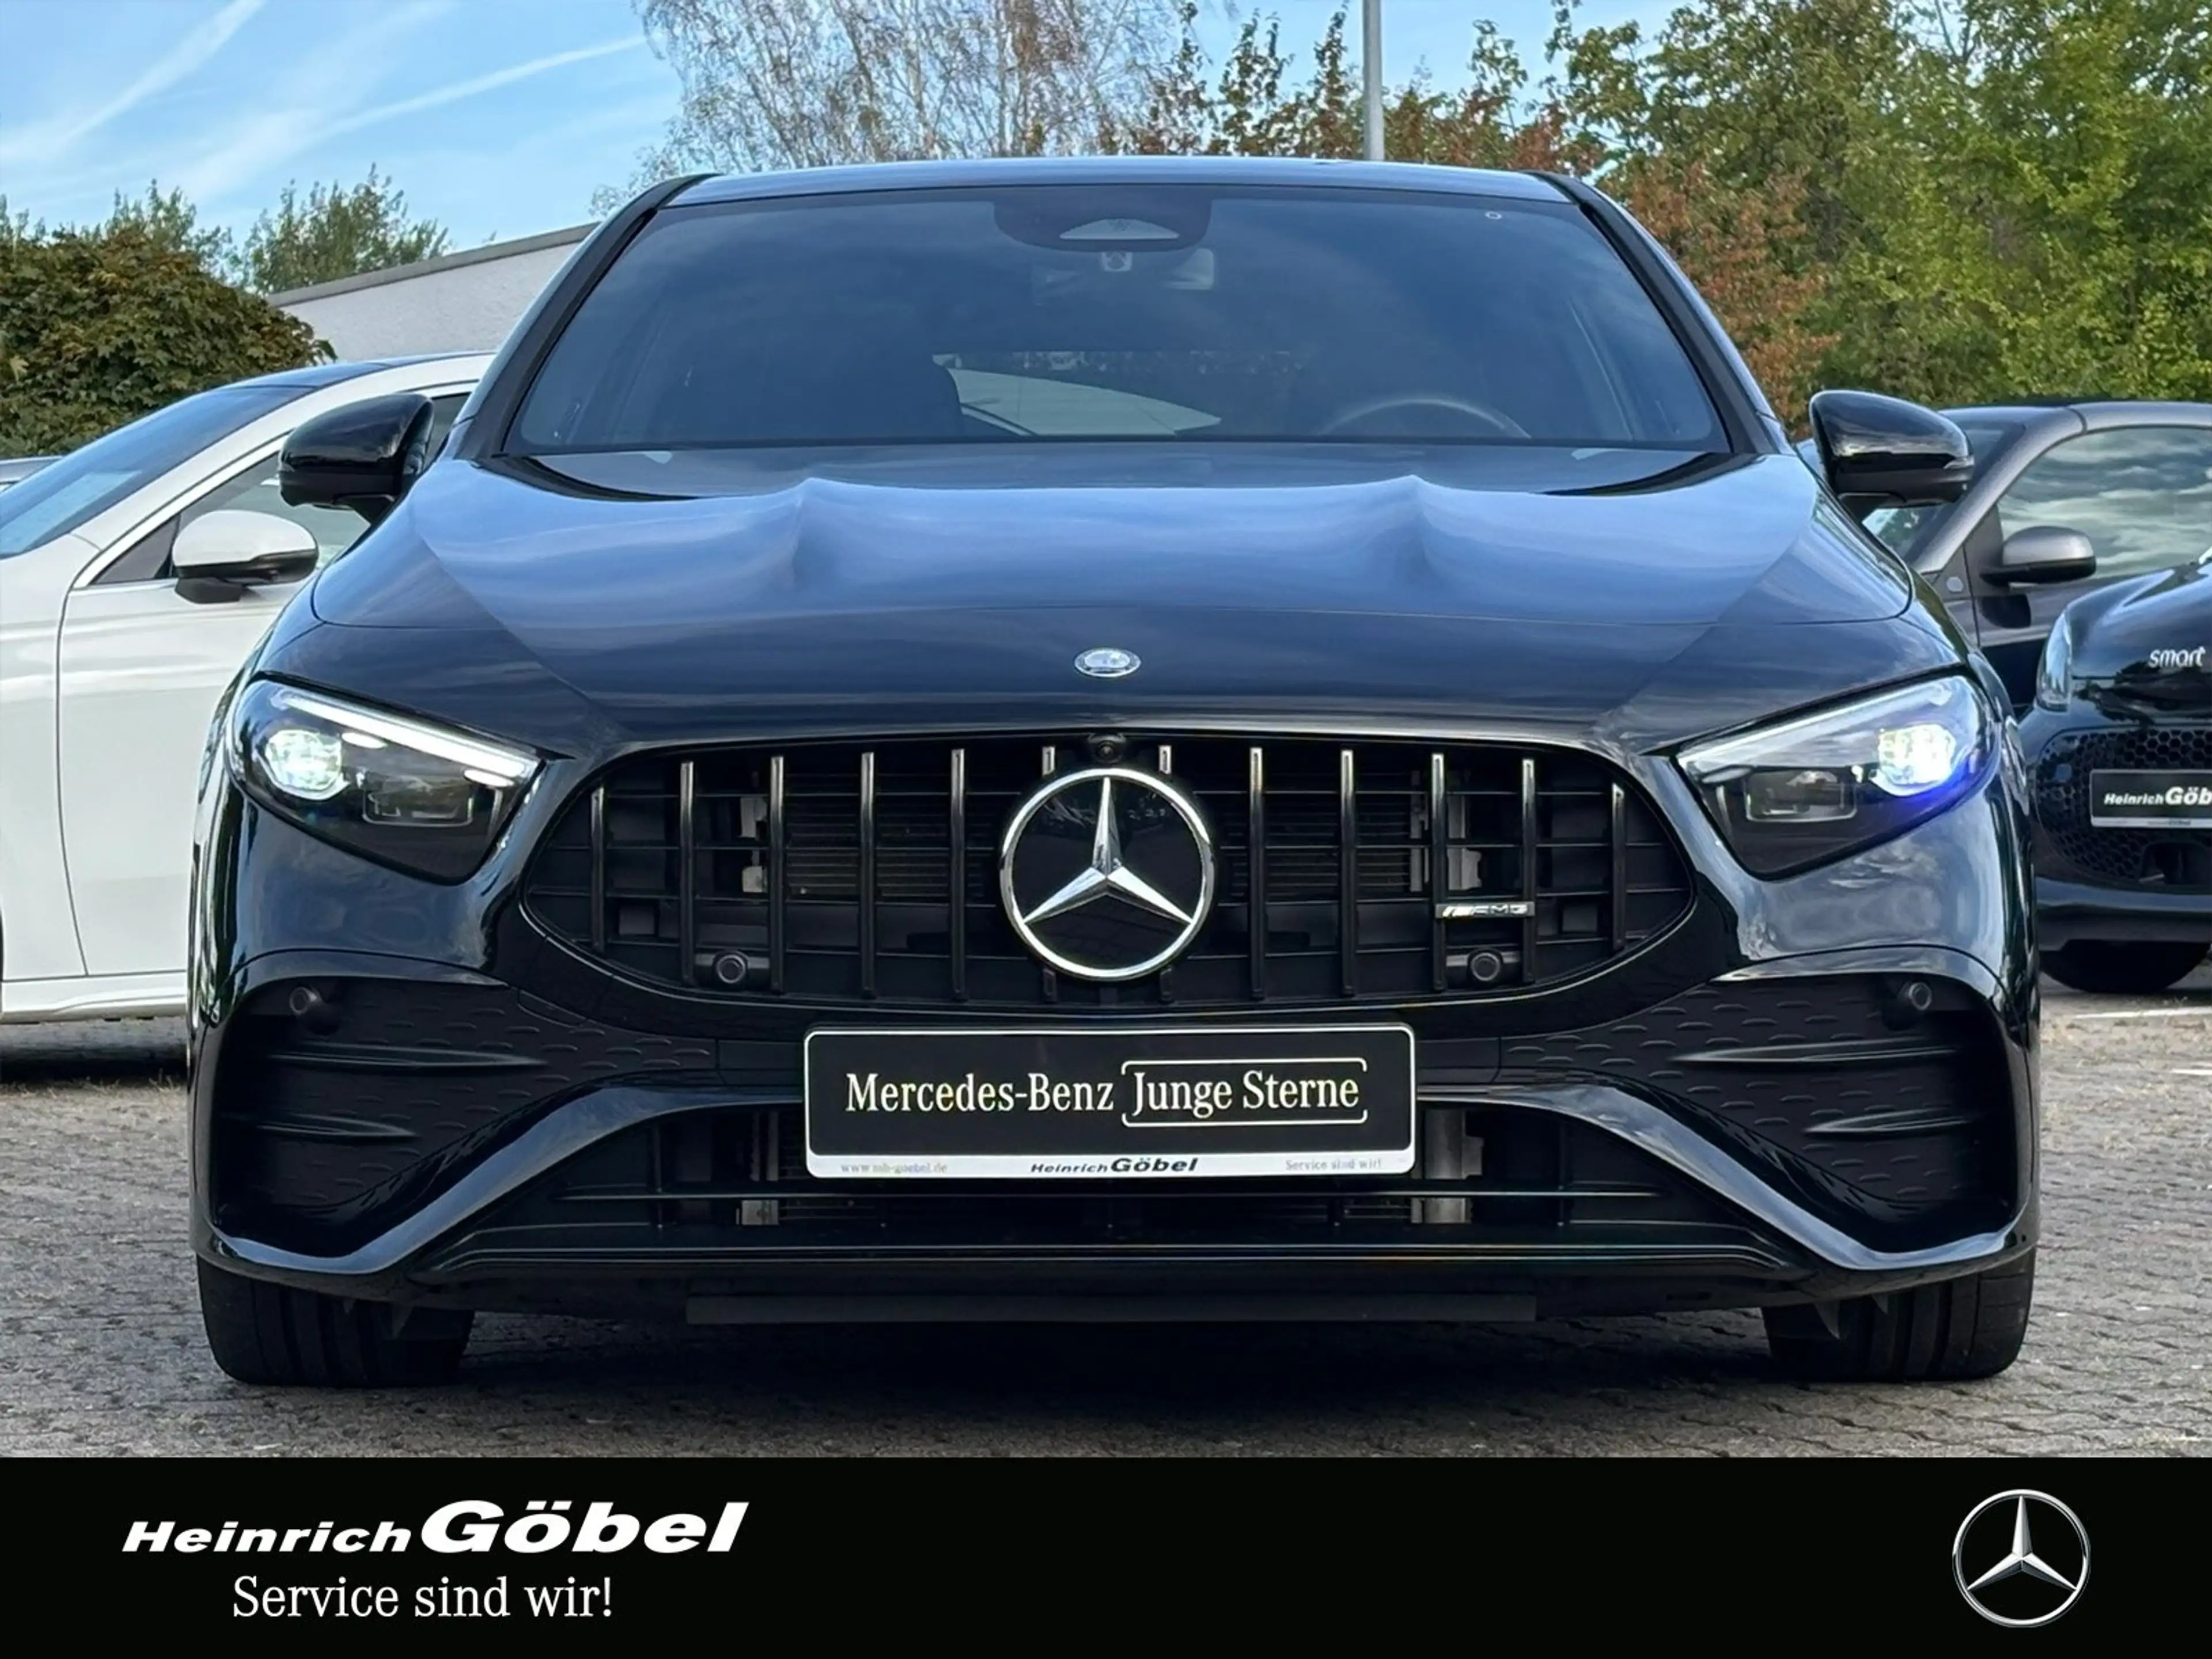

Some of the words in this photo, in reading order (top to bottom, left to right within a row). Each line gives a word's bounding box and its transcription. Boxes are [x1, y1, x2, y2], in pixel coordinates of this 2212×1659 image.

[2148, 646, 2205, 667] smart
[1471, 903, 1528, 917] AMG
[846, 1073, 1115, 1111] Mercedes-Benz
[1132, 1071, 1233, 1119] Junge
[1243, 1070, 1359, 1109] Sterne
[1286, 1159, 1328, 1171] Service
[1330, 1158, 1355, 1170] sid
